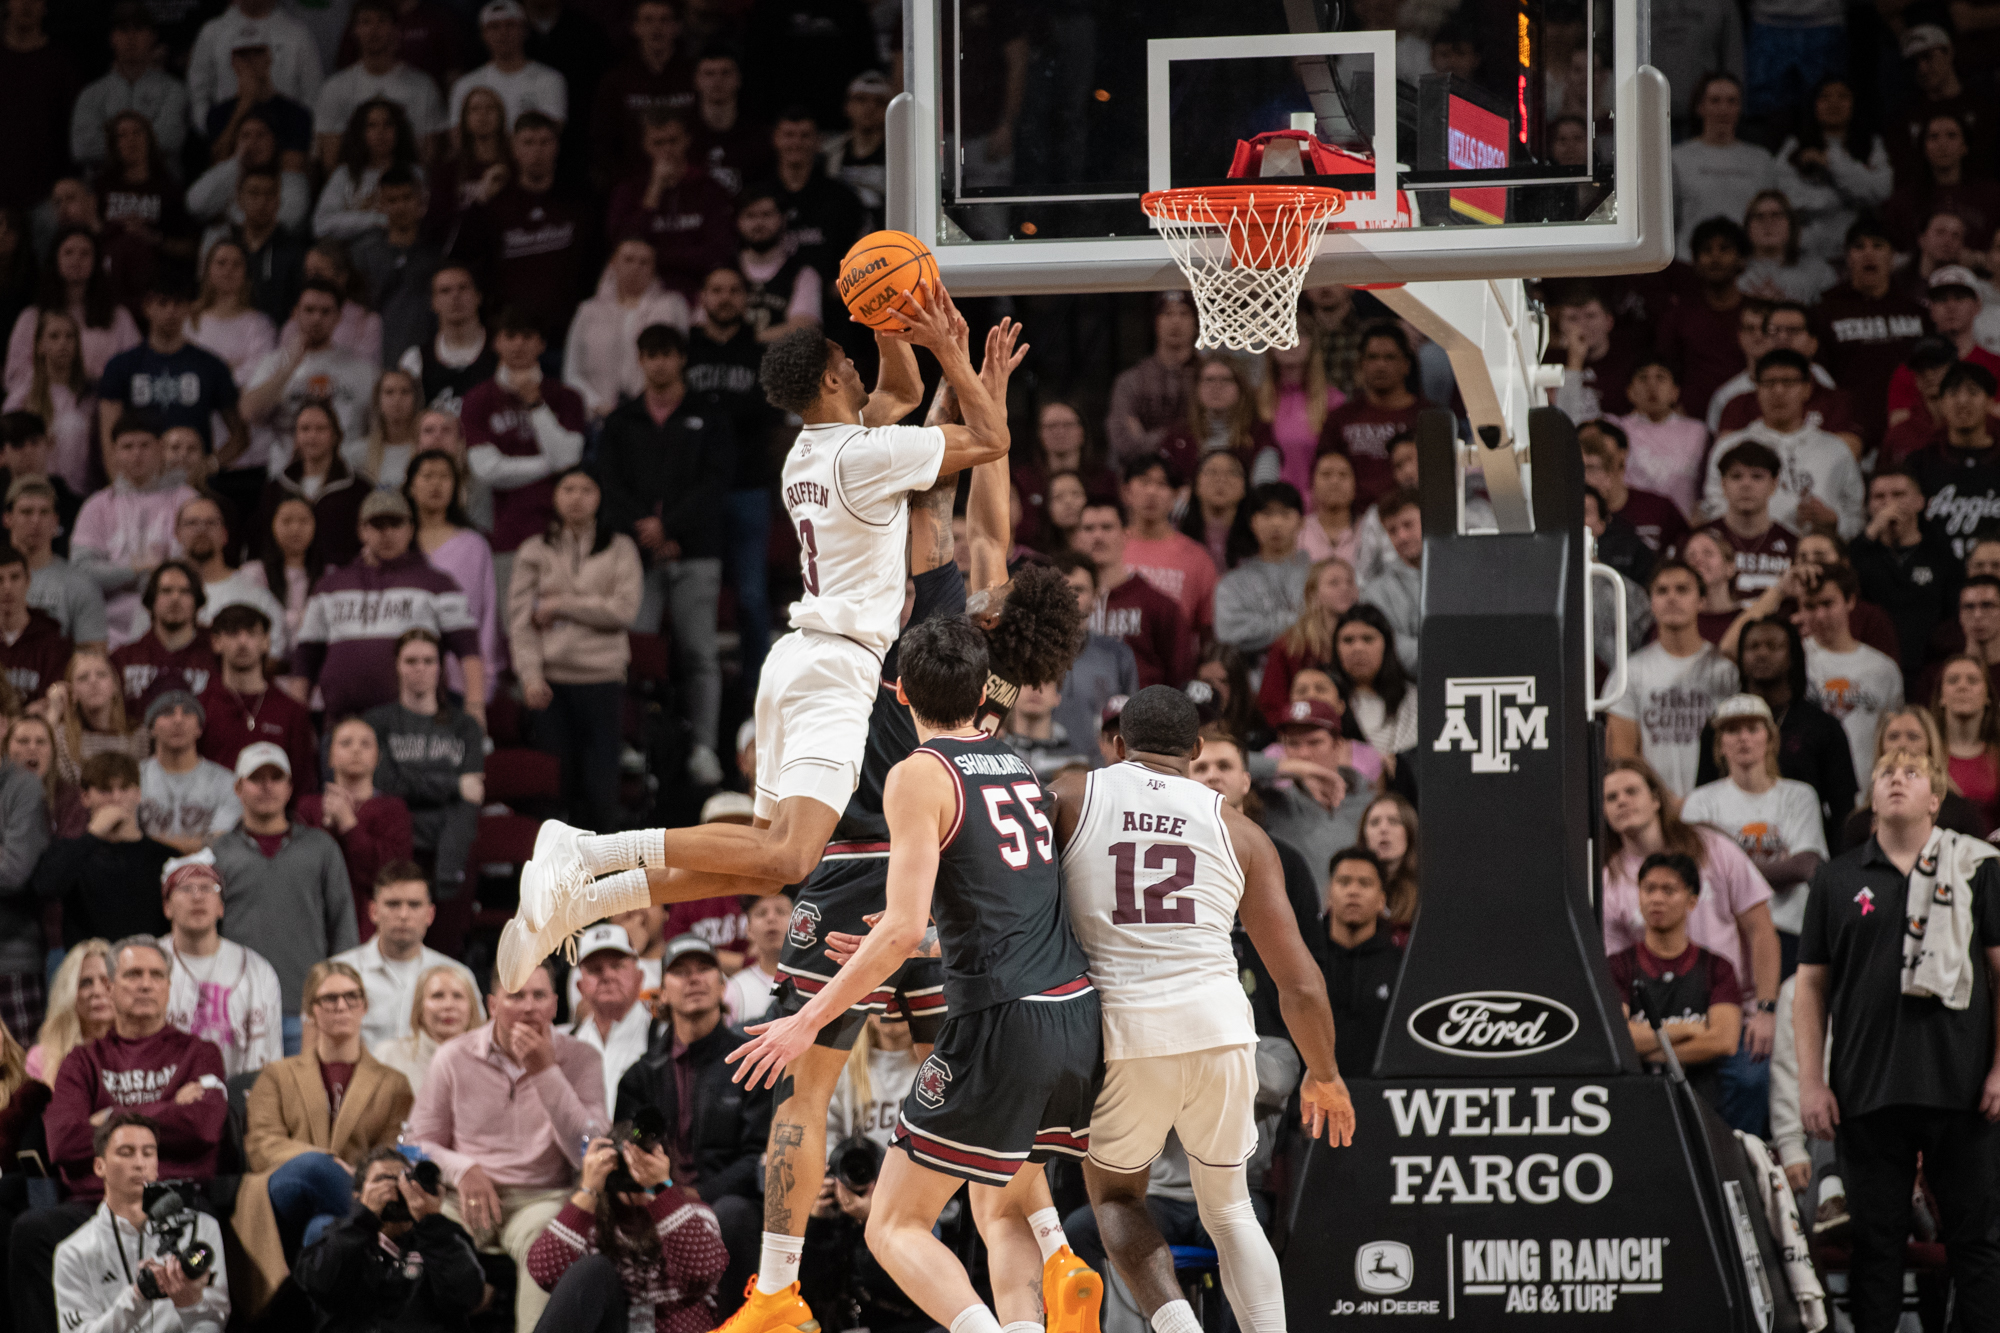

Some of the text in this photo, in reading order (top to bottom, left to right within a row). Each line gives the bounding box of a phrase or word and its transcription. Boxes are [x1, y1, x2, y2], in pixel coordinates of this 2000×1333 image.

[841, 257, 889, 298] Wilson
[859, 285, 899, 318] NCAA
[787, 480, 830, 513] RIFFEN
[979, 780, 1054, 872] 55
[1122, 811, 1188, 837] AGEE
[1108, 841, 1197, 925] 12
[1436, 999, 1550, 1047] Ford
[1382, 1084, 1612, 1137] WELLS
[1390, 1152, 1614, 1205] FARGO
[1462, 1238, 1541, 1282] KING
[1380, 1298, 1440, 1315] DEERE
[1505, 1283, 1619, 1313] AG & TURF
